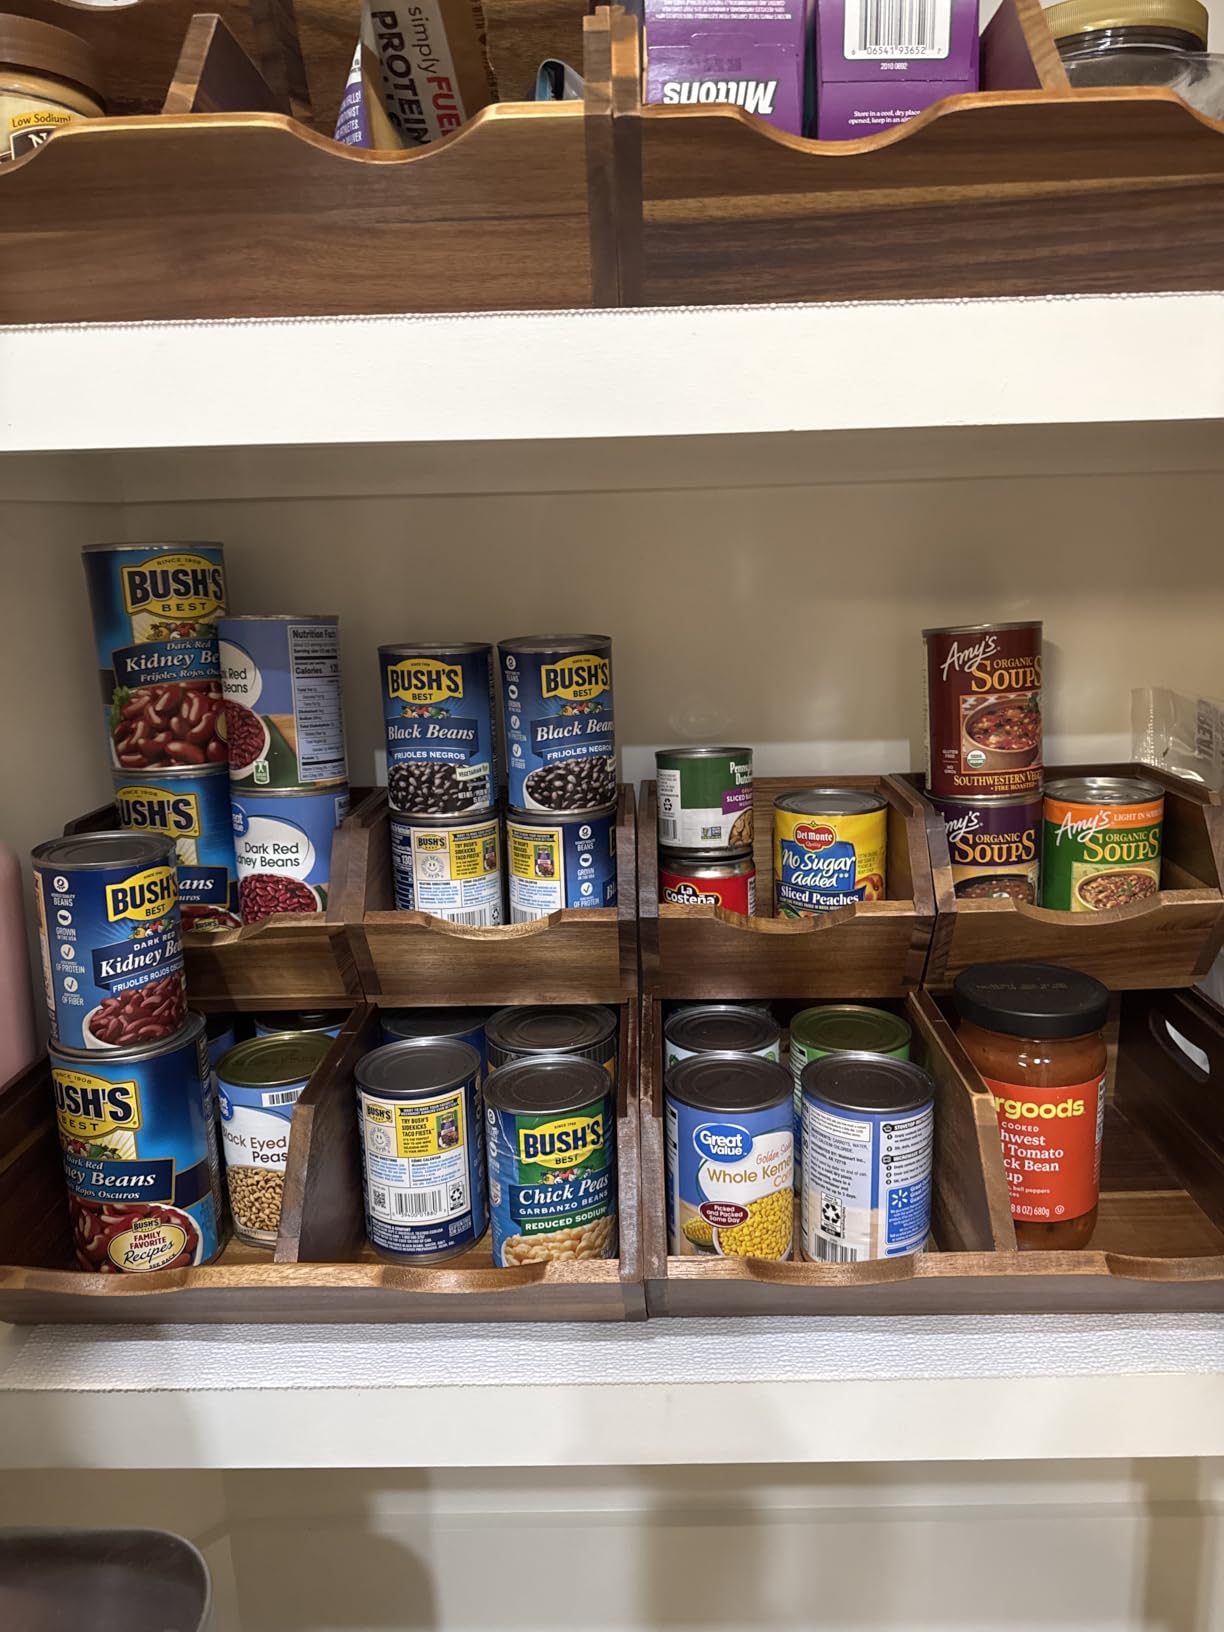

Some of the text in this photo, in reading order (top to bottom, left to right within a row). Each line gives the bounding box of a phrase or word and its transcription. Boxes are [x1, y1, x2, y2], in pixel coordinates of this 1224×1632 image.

[867, 46, 894, 55] 06541
[899, 46, 926, 54] 93652
[371, 11, 431, 144] PROTEIN
[663, 81, 777, 114] Miltons
[12, 113, 71, 128] Low Sodium!
[895, 110, 904, 118] dry
[127, 568, 224, 606] BUSH'S
[162, 602, 207, 612] BEST
[166, 640, 211, 651] Dark Red
[126, 653, 194, 673] Kidney
[940, 635, 999, 681] Amy's
[993, 656, 1033, 668] ORGANIC
[140, 671, 177, 683] Frijoles
[180, 670, 205, 680] Rojos
[228, 668, 247, 680] Red
[545, 662, 609, 693] BUSH'S
[971, 655, 1041, 692] SOUPS
[390, 669, 460, 693] BUSH'S
[412, 693, 433, 701] BEST
[573, 688, 593, 698] BEST
[388, 723, 475, 741] Black Beans
[536, 721, 581, 742] Black
[586, 718, 614, 734] Bean
[394, 751, 466, 760] FRIJOLES NEGROS
[547, 747, 587, 761] FRIJOLES
[954, 772, 1026, 786] SOUTHWESTERN
[120, 798, 194, 830] USH'S
[1113, 813, 1136, 821] LIGHT
[944, 811, 980, 843] my's
[1054, 810, 1111, 846] Amy's
[418, 836, 446, 847] BUSH'S
[796, 830, 833, 841] Del Monte
[975, 832, 1021, 843] ORGANIC
[1105, 831, 1148, 842] ORGANIC
[244, 842, 299, 855] Dark Red
[577, 843, 594, 851] BEANS
[954, 829, 1035, 863] SOUPS
[1083, 829, 1159, 862] SOUPS
[237, 854, 300, 868] dney Beans
[782, 849, 800, 869] No
[800, 854, 855, 876] Sugar
[179, 879, 214, 890] ans
[681, 885, 693, 895] La
[666, 890, 715, 904] Costeña
[781, 885, 859, 906] Sliced Peaches
[53, 898, 73, 907] BEANS
[145, 904, 166, 917] BEST
[56, 927, 76, 936] GROWN
[133, 931, 175, 951] DARK RED
[100, 940, 183, 978] Kidney Bea
[55, 963, 61, 971] OF
[62, 964, 85, 974] PROTEIN
[112, 967, 170, 993] FRIJOLES ROJOS
[68, 997, 84, 1006] FIBER
[74, 1075, 92, 1084] 1908
[56, 1080, 132, 1122] USH'S
[994, 1096, 1085, 1119] rgoods
[367, 1105, 391, 1120] BUSH'S
[1001, 1121, 1040, 1132] COOKED
[250, 1136, 287, 1152] Eyed
[524, 1120, 600, 1159] BUSH'S
[700, 1130, 743, 1147] Great
[1000, 1129, 1046, 1146] hwest
[252, 1151, 288, 1163] Peas
[710, 1145, 742, 1156] Value
[1008, 1144, 1064, 1159] Tomato
[85, 1160, 104, 1170] Red
[555, 1153, 580, 1165] BEST
[707, 1156, 792, 1184] Whole Kerne
[1024, 1160, 1059, 1172] Bean
[65, 1166, 156, 1187] ney Beans
[1006, 1172, 1023, 1184] up
[98, 1190, 140, 1200] Oscuros
[519, 1173, 609, 1205] Chick Peas
[519, 1189, 608, 1215] GARBANZO BEANS
[714, 1204, 736, 1212] Picked
[706, 1209, 719, 1217] and
[709, 1214, 726, 1223] Same
[1033, 1206, 1050, 1218] 680g
[133, 1220, 160, 1231] BUSH'S
[525, 1218, 573, 1231] REDUCED
[134, 1230, 161, 1242] FAMILY
[130, 1236, 167, 1250] FAVORITE
[123, 1239, 175, 1265] Recipes
